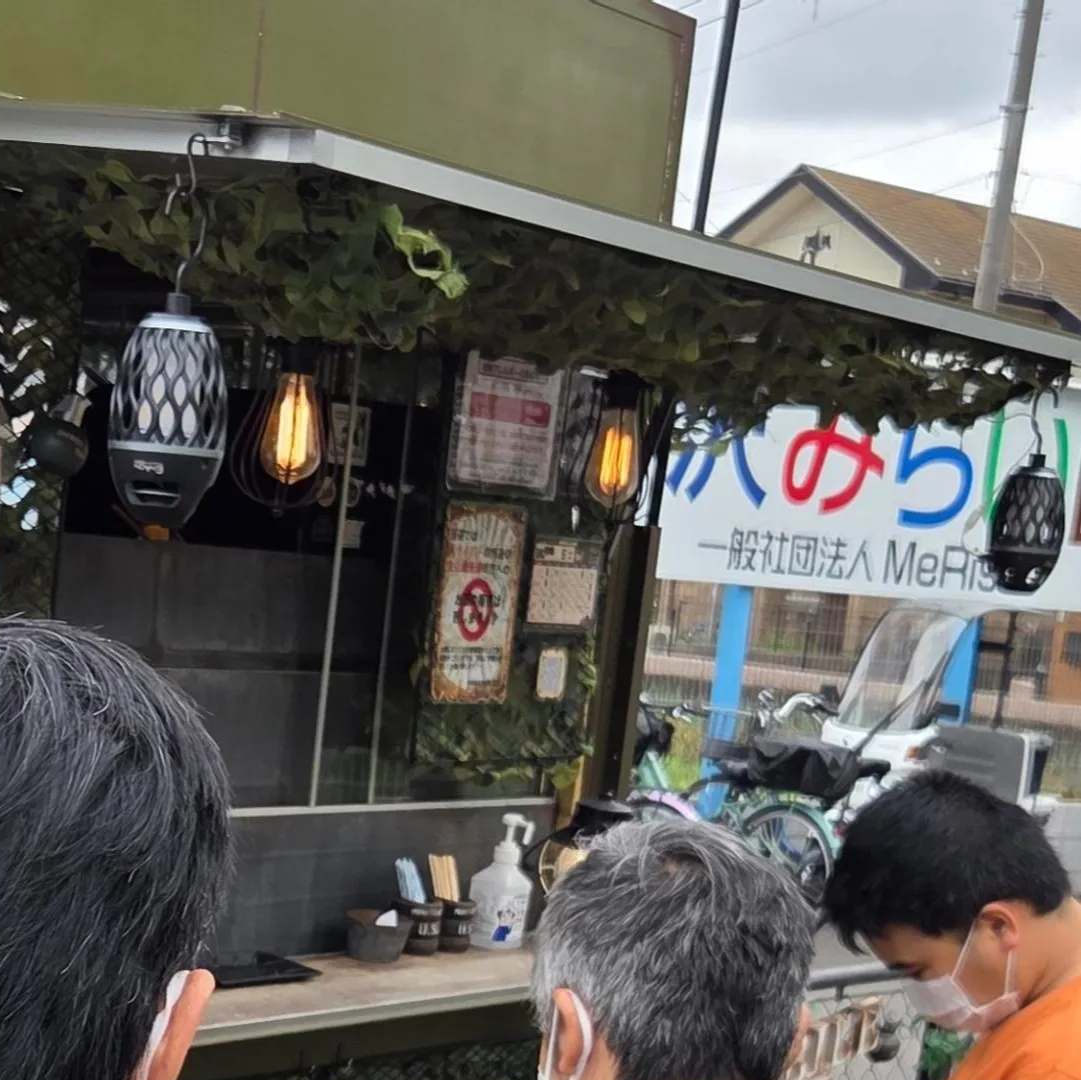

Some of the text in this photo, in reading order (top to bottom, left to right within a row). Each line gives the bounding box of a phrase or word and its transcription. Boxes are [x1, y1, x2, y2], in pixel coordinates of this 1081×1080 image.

[697, 526, 999, 594] 一般社団法人 MeRis
